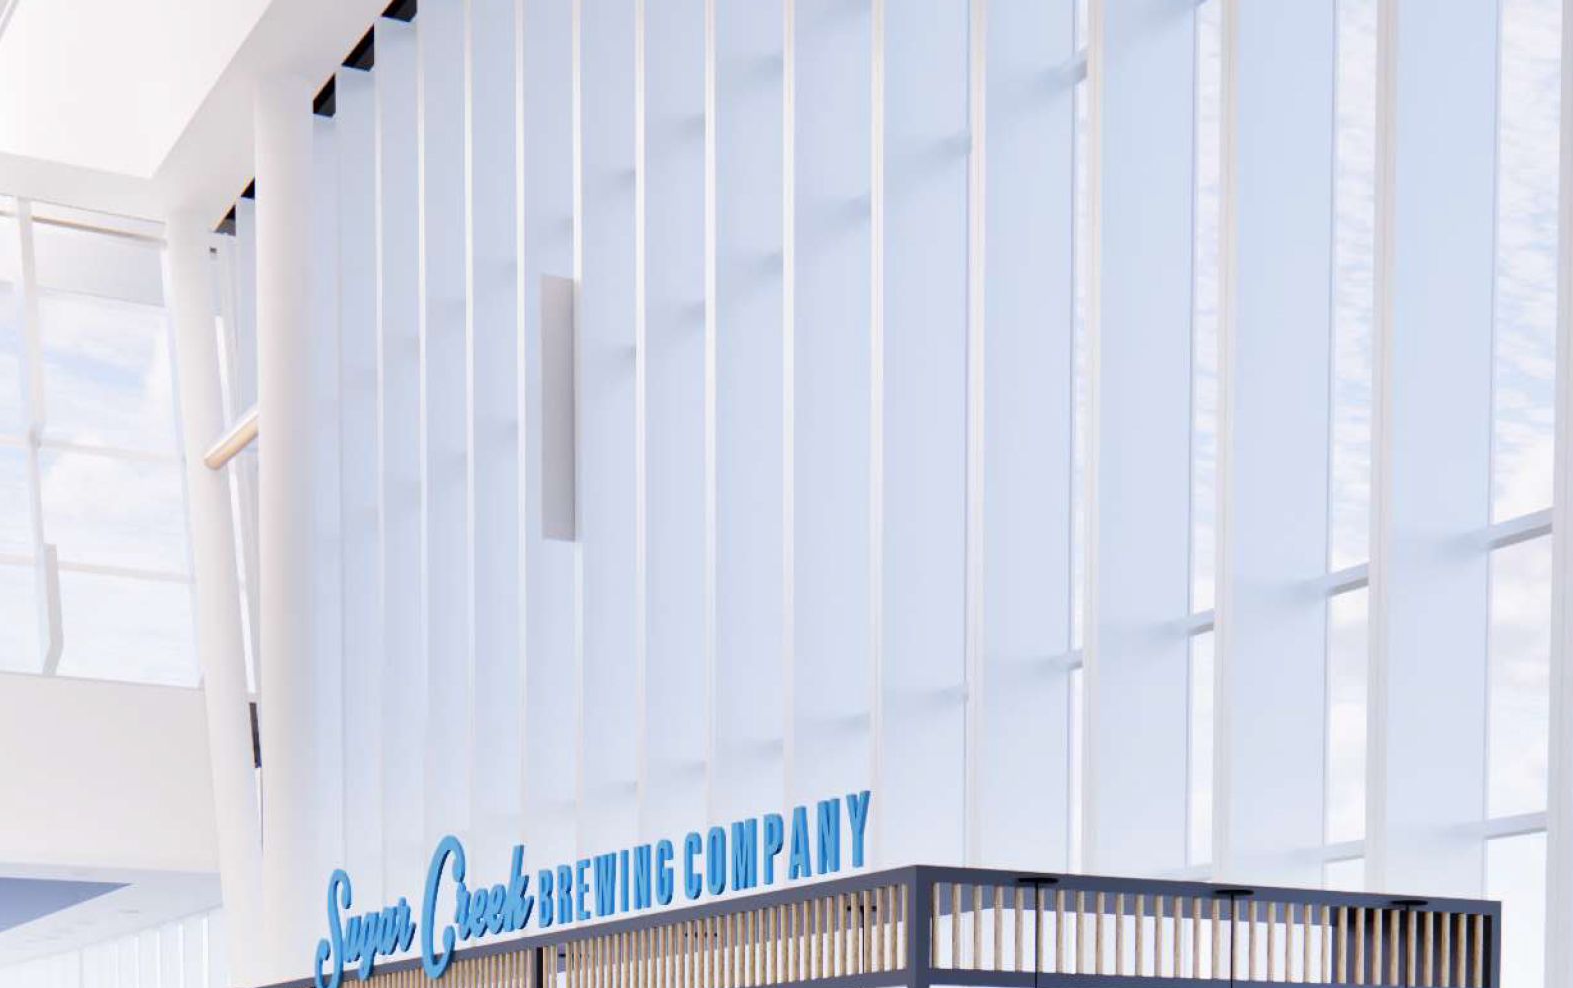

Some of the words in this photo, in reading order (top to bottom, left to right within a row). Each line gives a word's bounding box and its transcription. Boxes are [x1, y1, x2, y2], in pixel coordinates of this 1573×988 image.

[421, 834, 534, 980] Creek
[538, 838, 674, 928] BREWING
[684, 790, 871, 900] COMPANY
